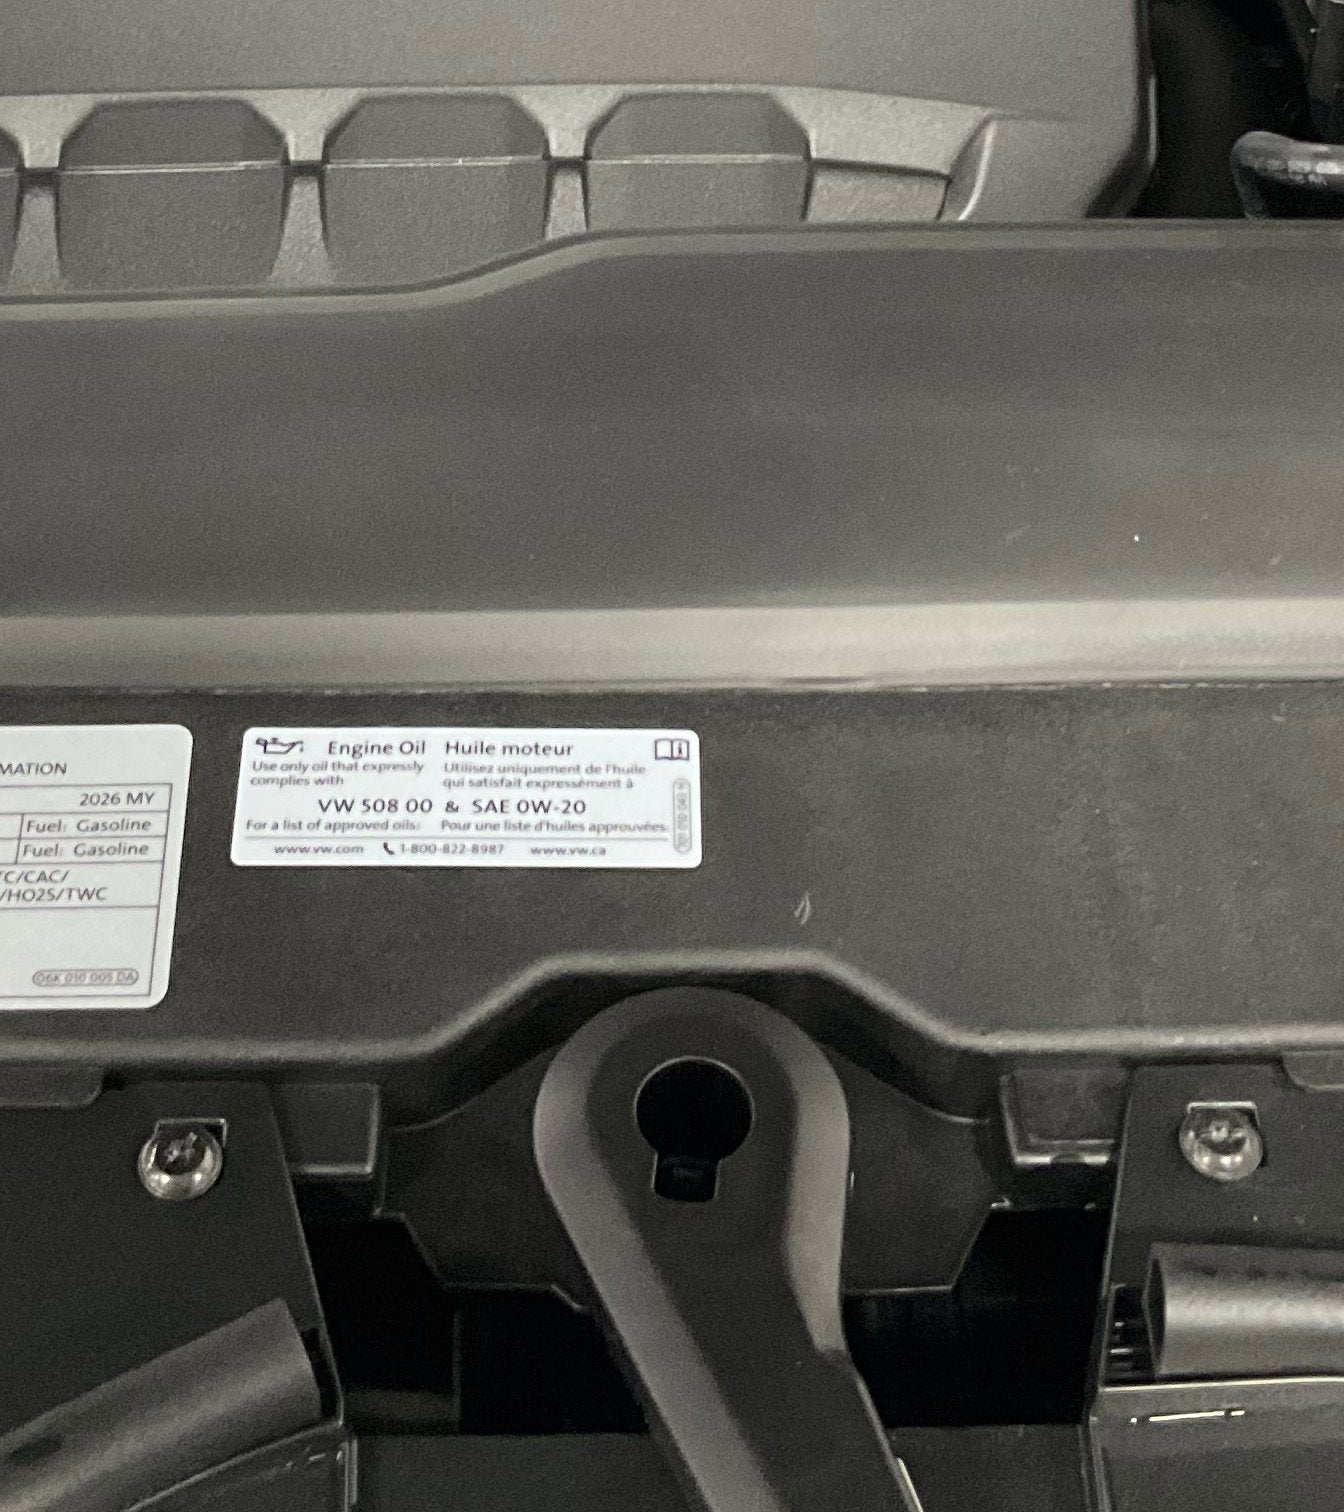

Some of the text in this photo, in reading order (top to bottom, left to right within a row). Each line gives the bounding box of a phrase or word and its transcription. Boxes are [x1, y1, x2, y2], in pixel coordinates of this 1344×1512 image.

[328, 740, 425, 758] Engine Oil
[445, 741, 574, 756] Huile moteur
[253, 760, 424, 775] Use only oil that expressly
[585, 763, 602, 774] de
[250, 775, 344, 789] complies with
[443, 778, 465, 790] qui
[80, 791, 156, 806] 2026 MY
[318, 798, 586, 814] VW 508 00 & SAE 0W-20
[76, 817, 152, 832] Gasoline
[246, 819, 267, 830] For
[271, 822, 279, 830] a
[283, 818, 303, 830] list
[307, 818, 321, 830] of
[325, 818, 389, 833] approved
[442, 820, 470, 831] Pour
[475, 822, 500, 832] une
[504, 820, 530, 832] liste
[74, 842, 149, 857] Gasoline
[274, 845, 365, 855] www.vw.com
[400, 844, 504, 855] 1-800-822-8987
[531, 846, 606, 856] www.vw.ca
